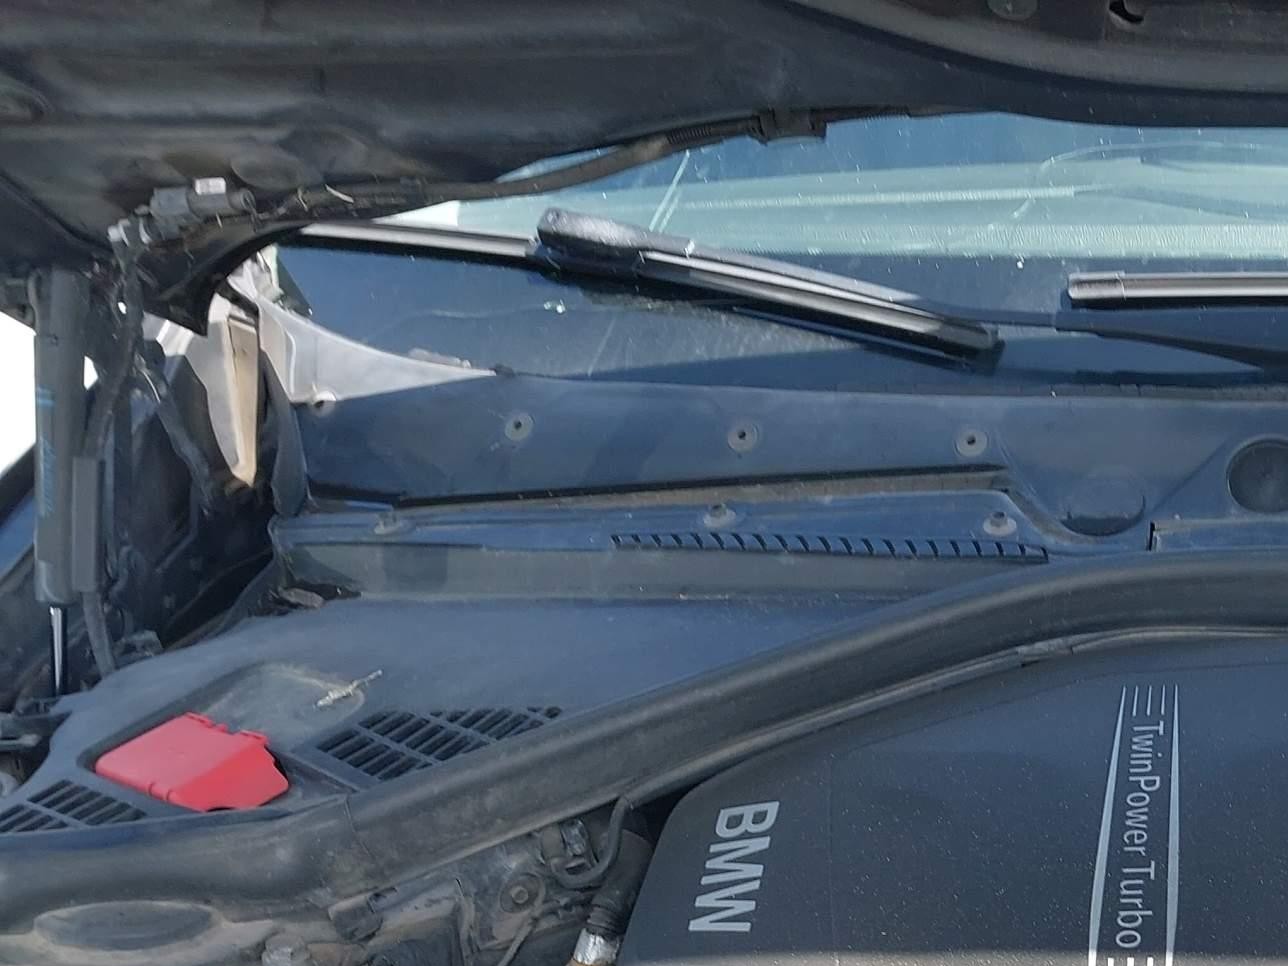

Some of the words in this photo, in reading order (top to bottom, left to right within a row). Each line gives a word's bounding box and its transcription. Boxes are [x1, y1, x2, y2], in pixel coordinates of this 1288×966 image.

[1123, 720, 1164, 856] TwinPower
[688, 801, 780, 932] BMW
[1115, 860, 1155, 948] Turbo
